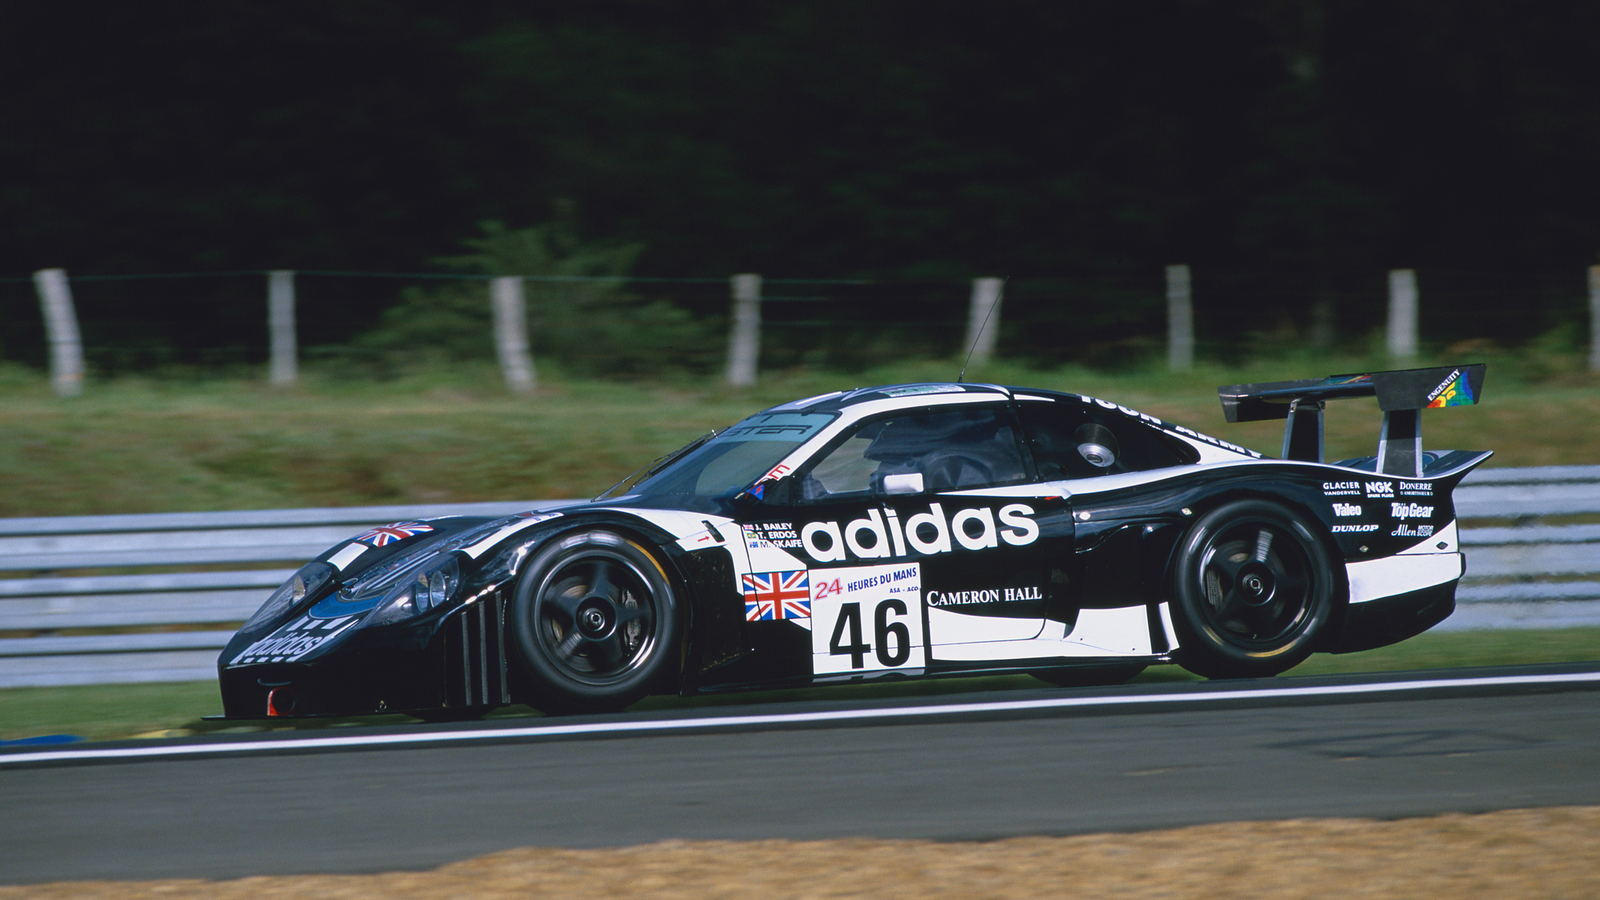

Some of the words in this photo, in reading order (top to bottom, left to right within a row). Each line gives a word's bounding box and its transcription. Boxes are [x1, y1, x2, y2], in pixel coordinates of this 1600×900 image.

[1427, 369, 1460, 401] ENGENUITY
[1322, 481, 1360, 490] GLACIER
[1365, 481, 1394, 493] NGK
[1399, 481, 1433, 491] DONERRE
[1332, 503, 1362, 517] Valeo
[755, 523, 762, 531] J.
[762, 522, 792, 531] BAILEY
[800, 503, 1039, 562] adidas
[1331, 524, 1379, 533] DUNLOP
[1391, 524, 1416, 537] Allen
[757, 531, 767, 540] T.
[767, 530, 798, 540] ERDOS
[759, 540, 771, 548] M.
[772, 539, 803, 548] SKAIFE
[814, 577, 843, 601] 24
[847, 576, 878, 592] HEURES
[879, 572, 891, 585] DU
[893, 567, 917, 580] MANS
[926, 589, 999, 606] CAMERON
[1004, 586, 1043, 602] HALL
[830, 598, 911, 669] 46
